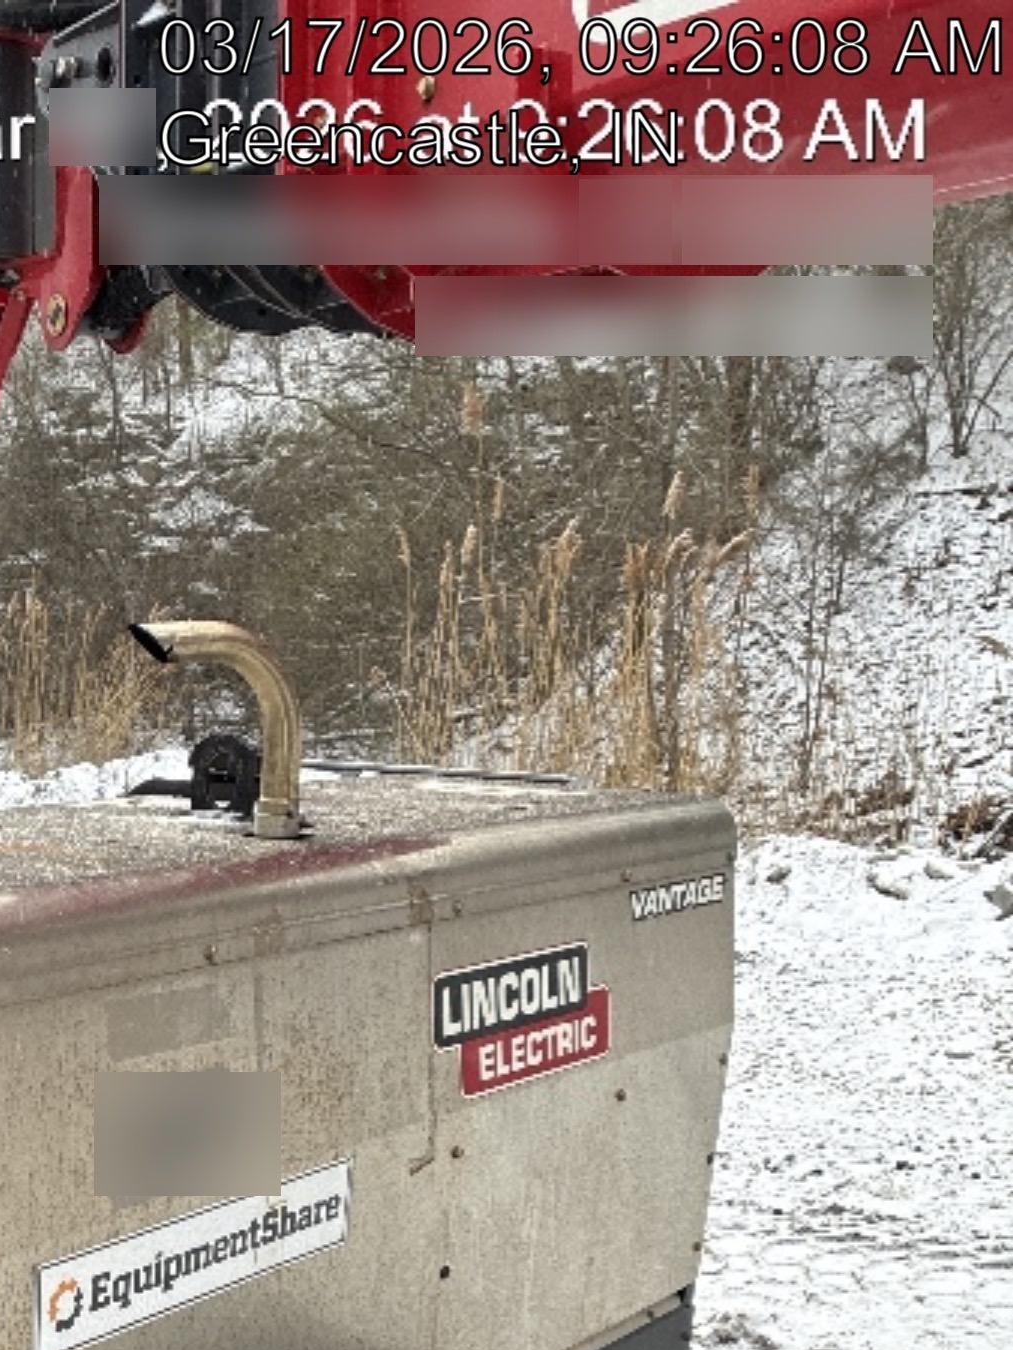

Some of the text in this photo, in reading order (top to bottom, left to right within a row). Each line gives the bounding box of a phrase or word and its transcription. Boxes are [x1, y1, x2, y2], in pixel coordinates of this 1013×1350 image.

[629, 873, 725, 921] VANTAGE
[442, 955, 582, 1039] LINCOLN
[478, 1015, 598, 1082] ELECTRIC
[88, 1193, 340, 1313] EquipmentShare
